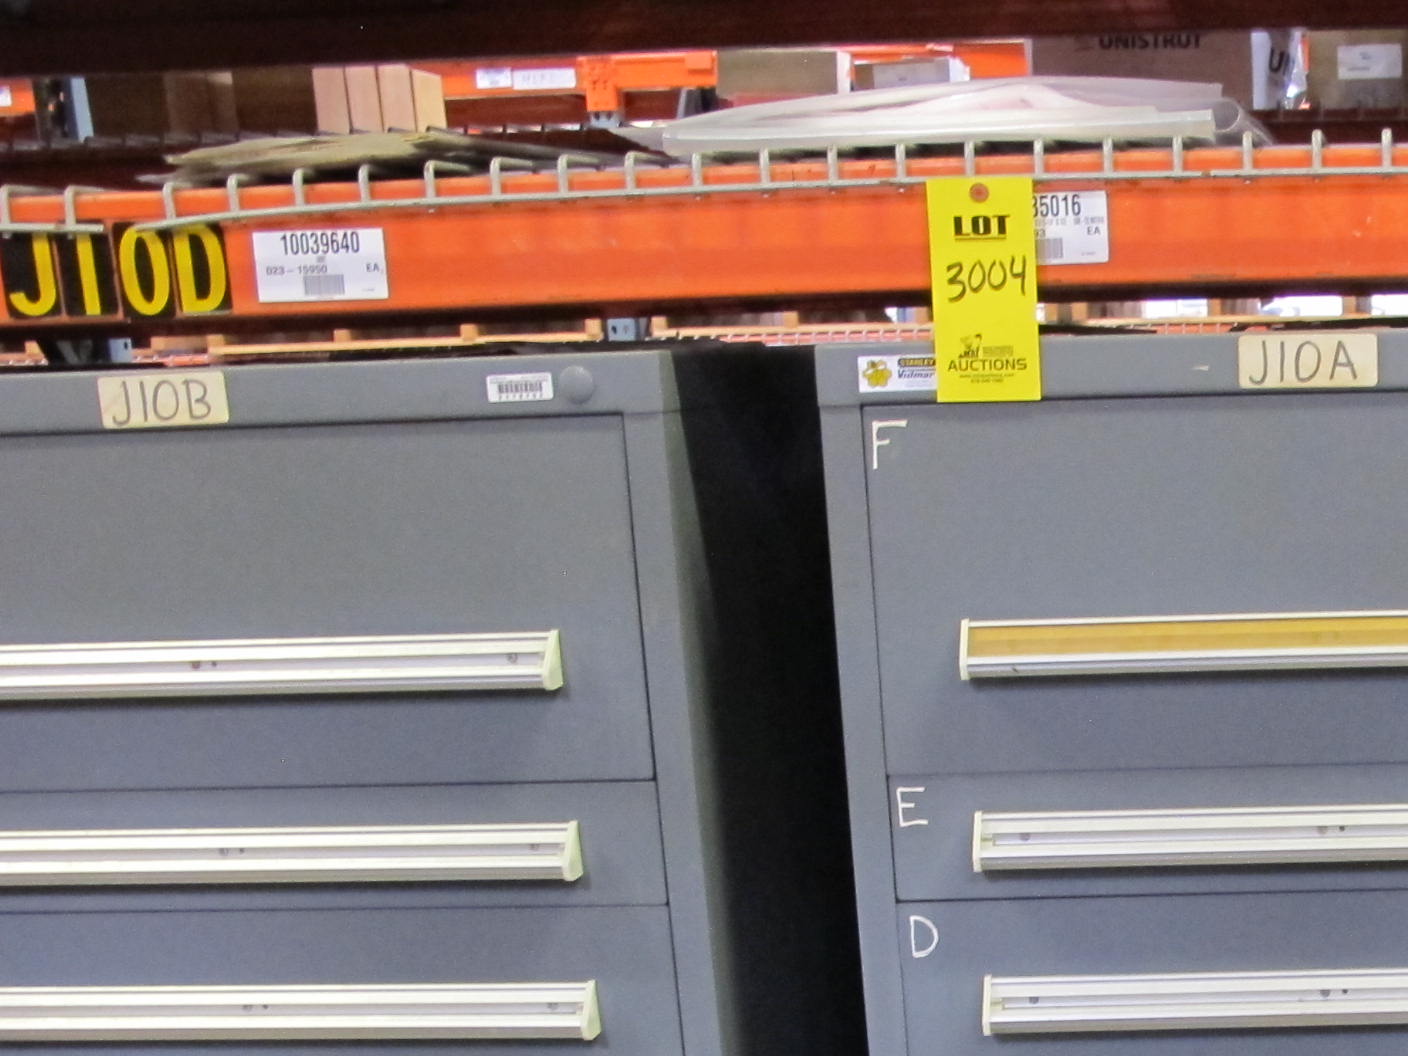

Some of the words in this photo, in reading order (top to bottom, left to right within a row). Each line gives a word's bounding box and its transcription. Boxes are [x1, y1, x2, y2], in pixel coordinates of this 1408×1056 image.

[1101, 34, 1200, 49] UNISTRUT
[953, 214, 1010, 236] LOT
[280, 231, 360, 256] 10039640
[946, 254, 1027, 303] 3004
[947, 358, 1028, 372] AUCTIONS
[871, 420, 908, 470] F
[896, 786, 929, 828] E
[909, 915, 940, 959] D
